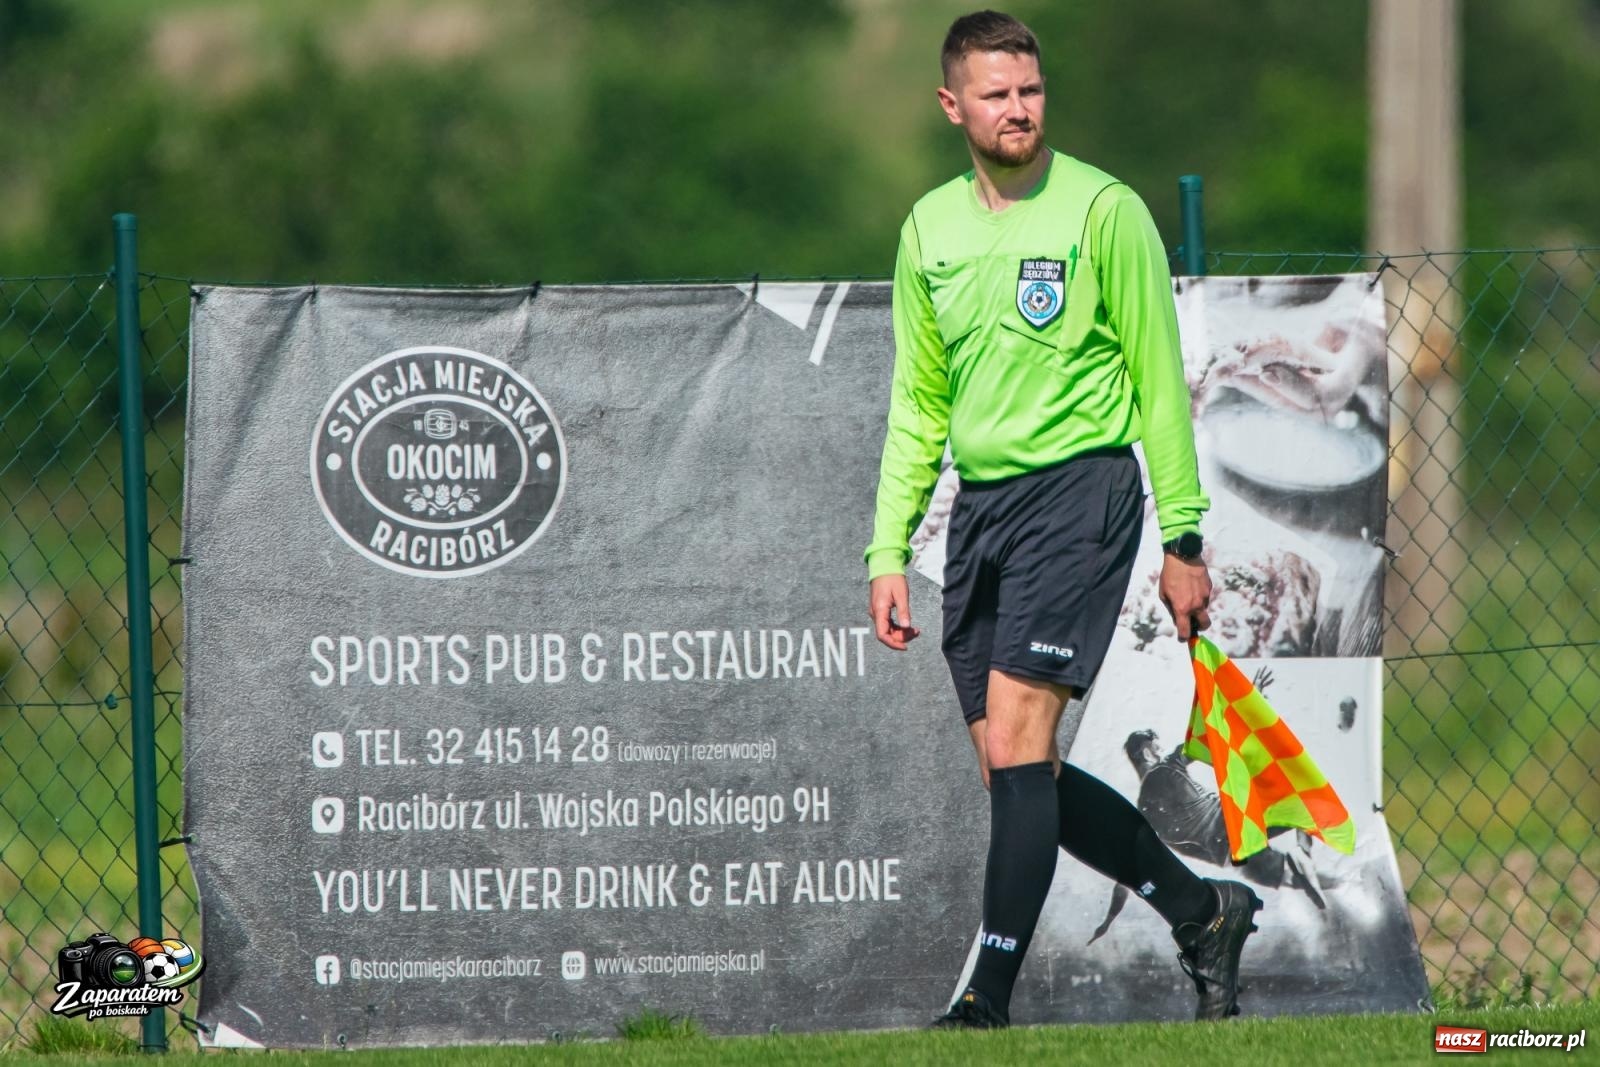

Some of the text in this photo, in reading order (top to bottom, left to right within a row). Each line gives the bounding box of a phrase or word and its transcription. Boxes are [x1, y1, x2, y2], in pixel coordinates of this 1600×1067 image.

[327, 360, 548, 446] STACJA MIEJSKA
[387, 444, 497, 480] OKOCIM
[370, 519, 514, 566] RACIBÓRZ
[310, 627, 870, 686] SPORTS PUB & RESTAURANT
[355, 729, 416, 765] TEL.
[427, 728, 464, 764] 32
[474, 727, 523, 764] 415
[532, 726, 561, 763] 14
[572, 726, 609, 763] 28
[617, 741, 680, 764] (dowozy
[691, 738, 777, 763] rezerwacje)
[358, 787, 830, 837] Racibórz ul. Wojska Polskiego 9H
[312, 858, 901, 914] YOU'LL NEVER DRINK & EAT ALONE
[350, 955, 542, 983] @stacjamiejskaraciborz
[594, 949, 765, 978] www.stacjamiejska.pl
